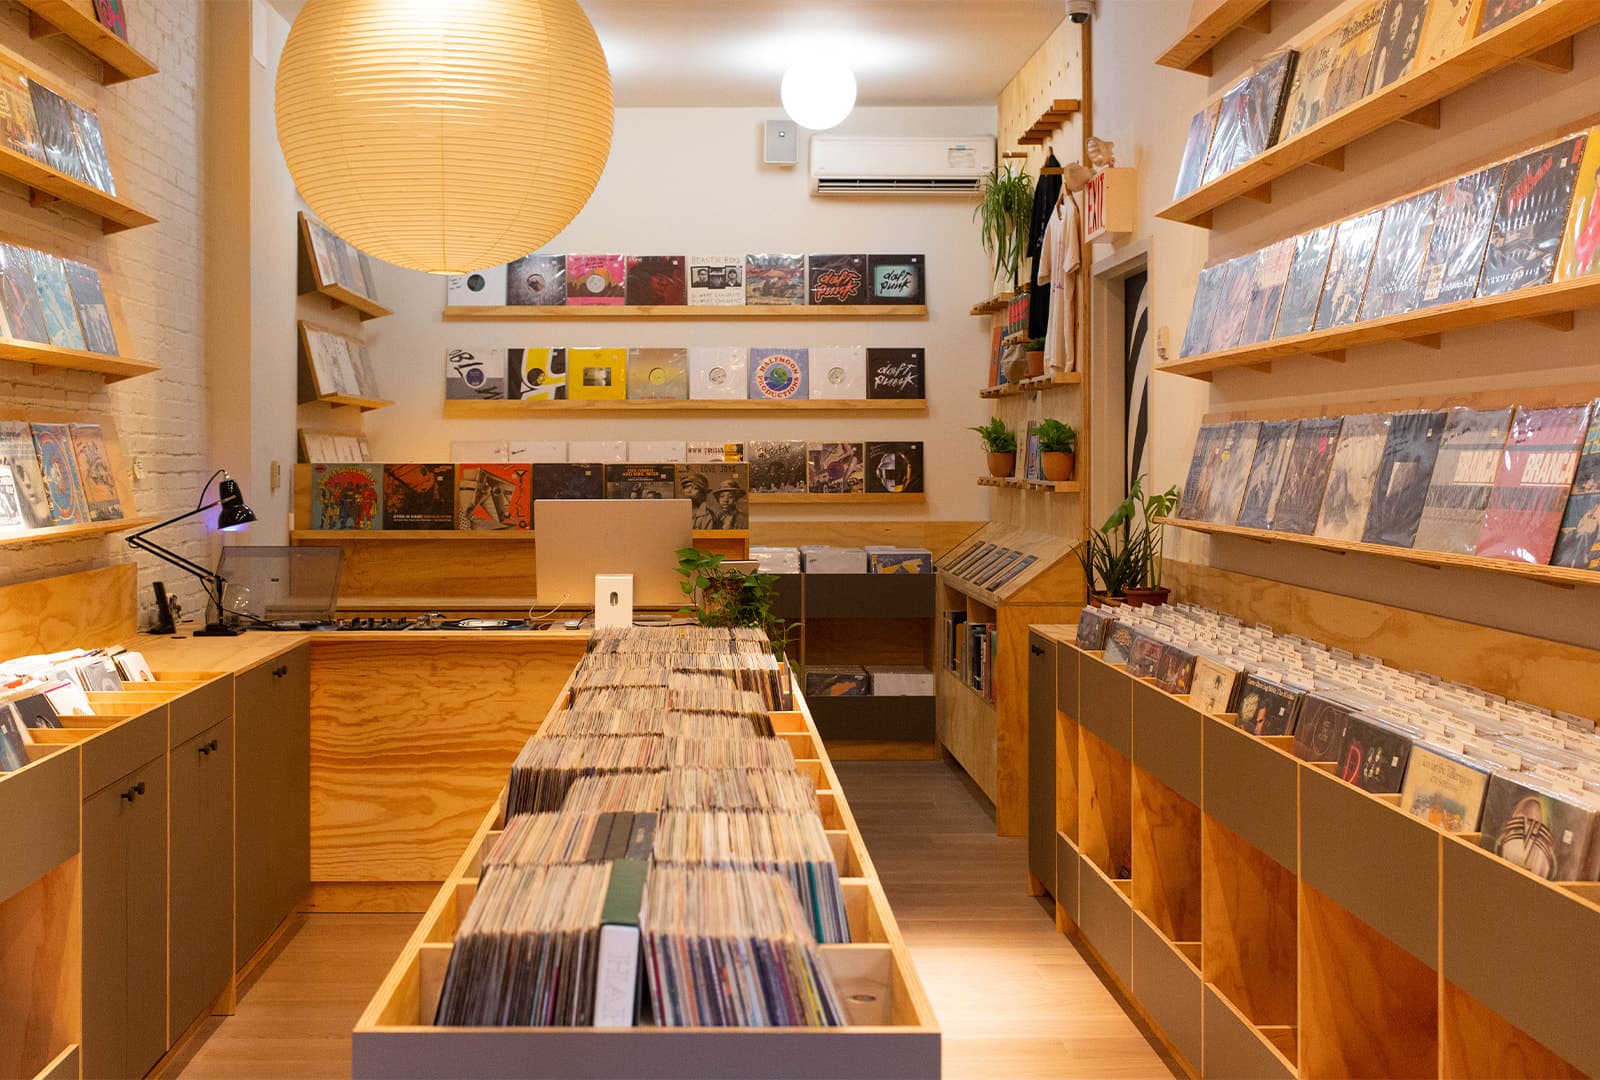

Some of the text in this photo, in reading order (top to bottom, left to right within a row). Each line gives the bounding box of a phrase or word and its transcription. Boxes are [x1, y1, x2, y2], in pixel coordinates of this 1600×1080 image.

[1087, 172, 1105, 236] EXIT
[818, 269, 860, 285] daft
[882, 269, 912, 281] daft
[815, 280, 860, 302] punk
[879, 279, 911, 293] punk
[758, 354, 799, 376] HALFMOON
[877, 362, 917, 376] daft
[756, 374, 799, 398] PRODUCTIONS
[874, 373, 918, 389] punk
[1521, 451, 1577, 484] BRANCA
